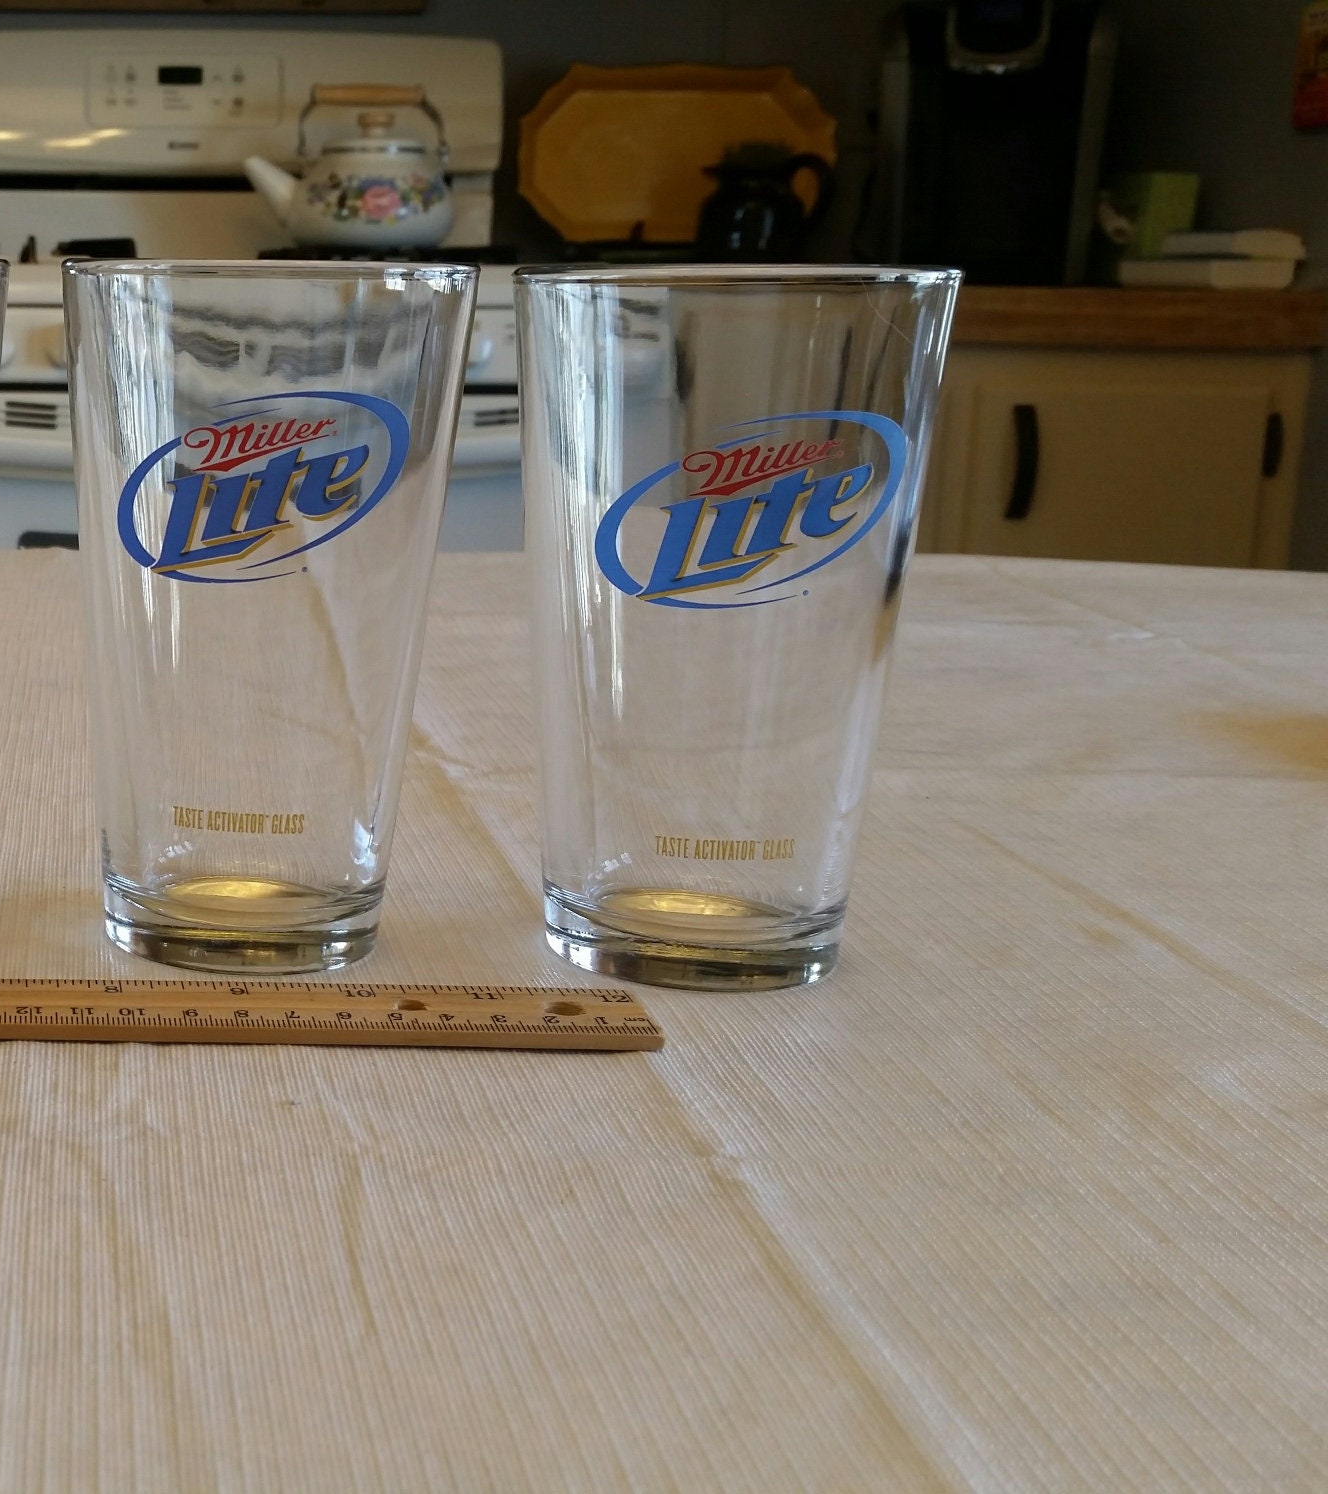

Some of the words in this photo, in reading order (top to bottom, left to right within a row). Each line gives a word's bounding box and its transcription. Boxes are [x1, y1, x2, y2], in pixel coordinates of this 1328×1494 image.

[184, 418, 337, 464] Miller
[682, 439, 840, 489] Miller
[152, 445, 370, 573] Lite
[636, 463, 874, 600] Lite
[173, 806, 203, 829] TASTE
[272, 814, 305, 834] GLASS
[656, 836, 690, 859] TASTE
[762, 838, 796, 860] GLASS
[104, 985, 119, 993] 8
[230, 987, 245, 996] 9
[346, 990, 372, 998] 10
[472, 992, 498, 1000] 11
[600, 995, 629, 1003] 12
[16, 1006, 43, 1014] 12
[70, 1007, 94, 1015] 11
[118, 1008, 146, 1016] 10
[185, 1009, 198, 1018] 9
[236, 1010, 249, 1018] 8
[288, 1011, 300, 1019] 7
[339, 1012, 352, 1020] 6
[390, 1012, 403, 1021] 5
[439, 1013, 454, 1022] 4
[492, 1015, 507, 1023] 3
[545, 1016, 560, 1024] 2
[596, 1016, 608, 1025] 1
